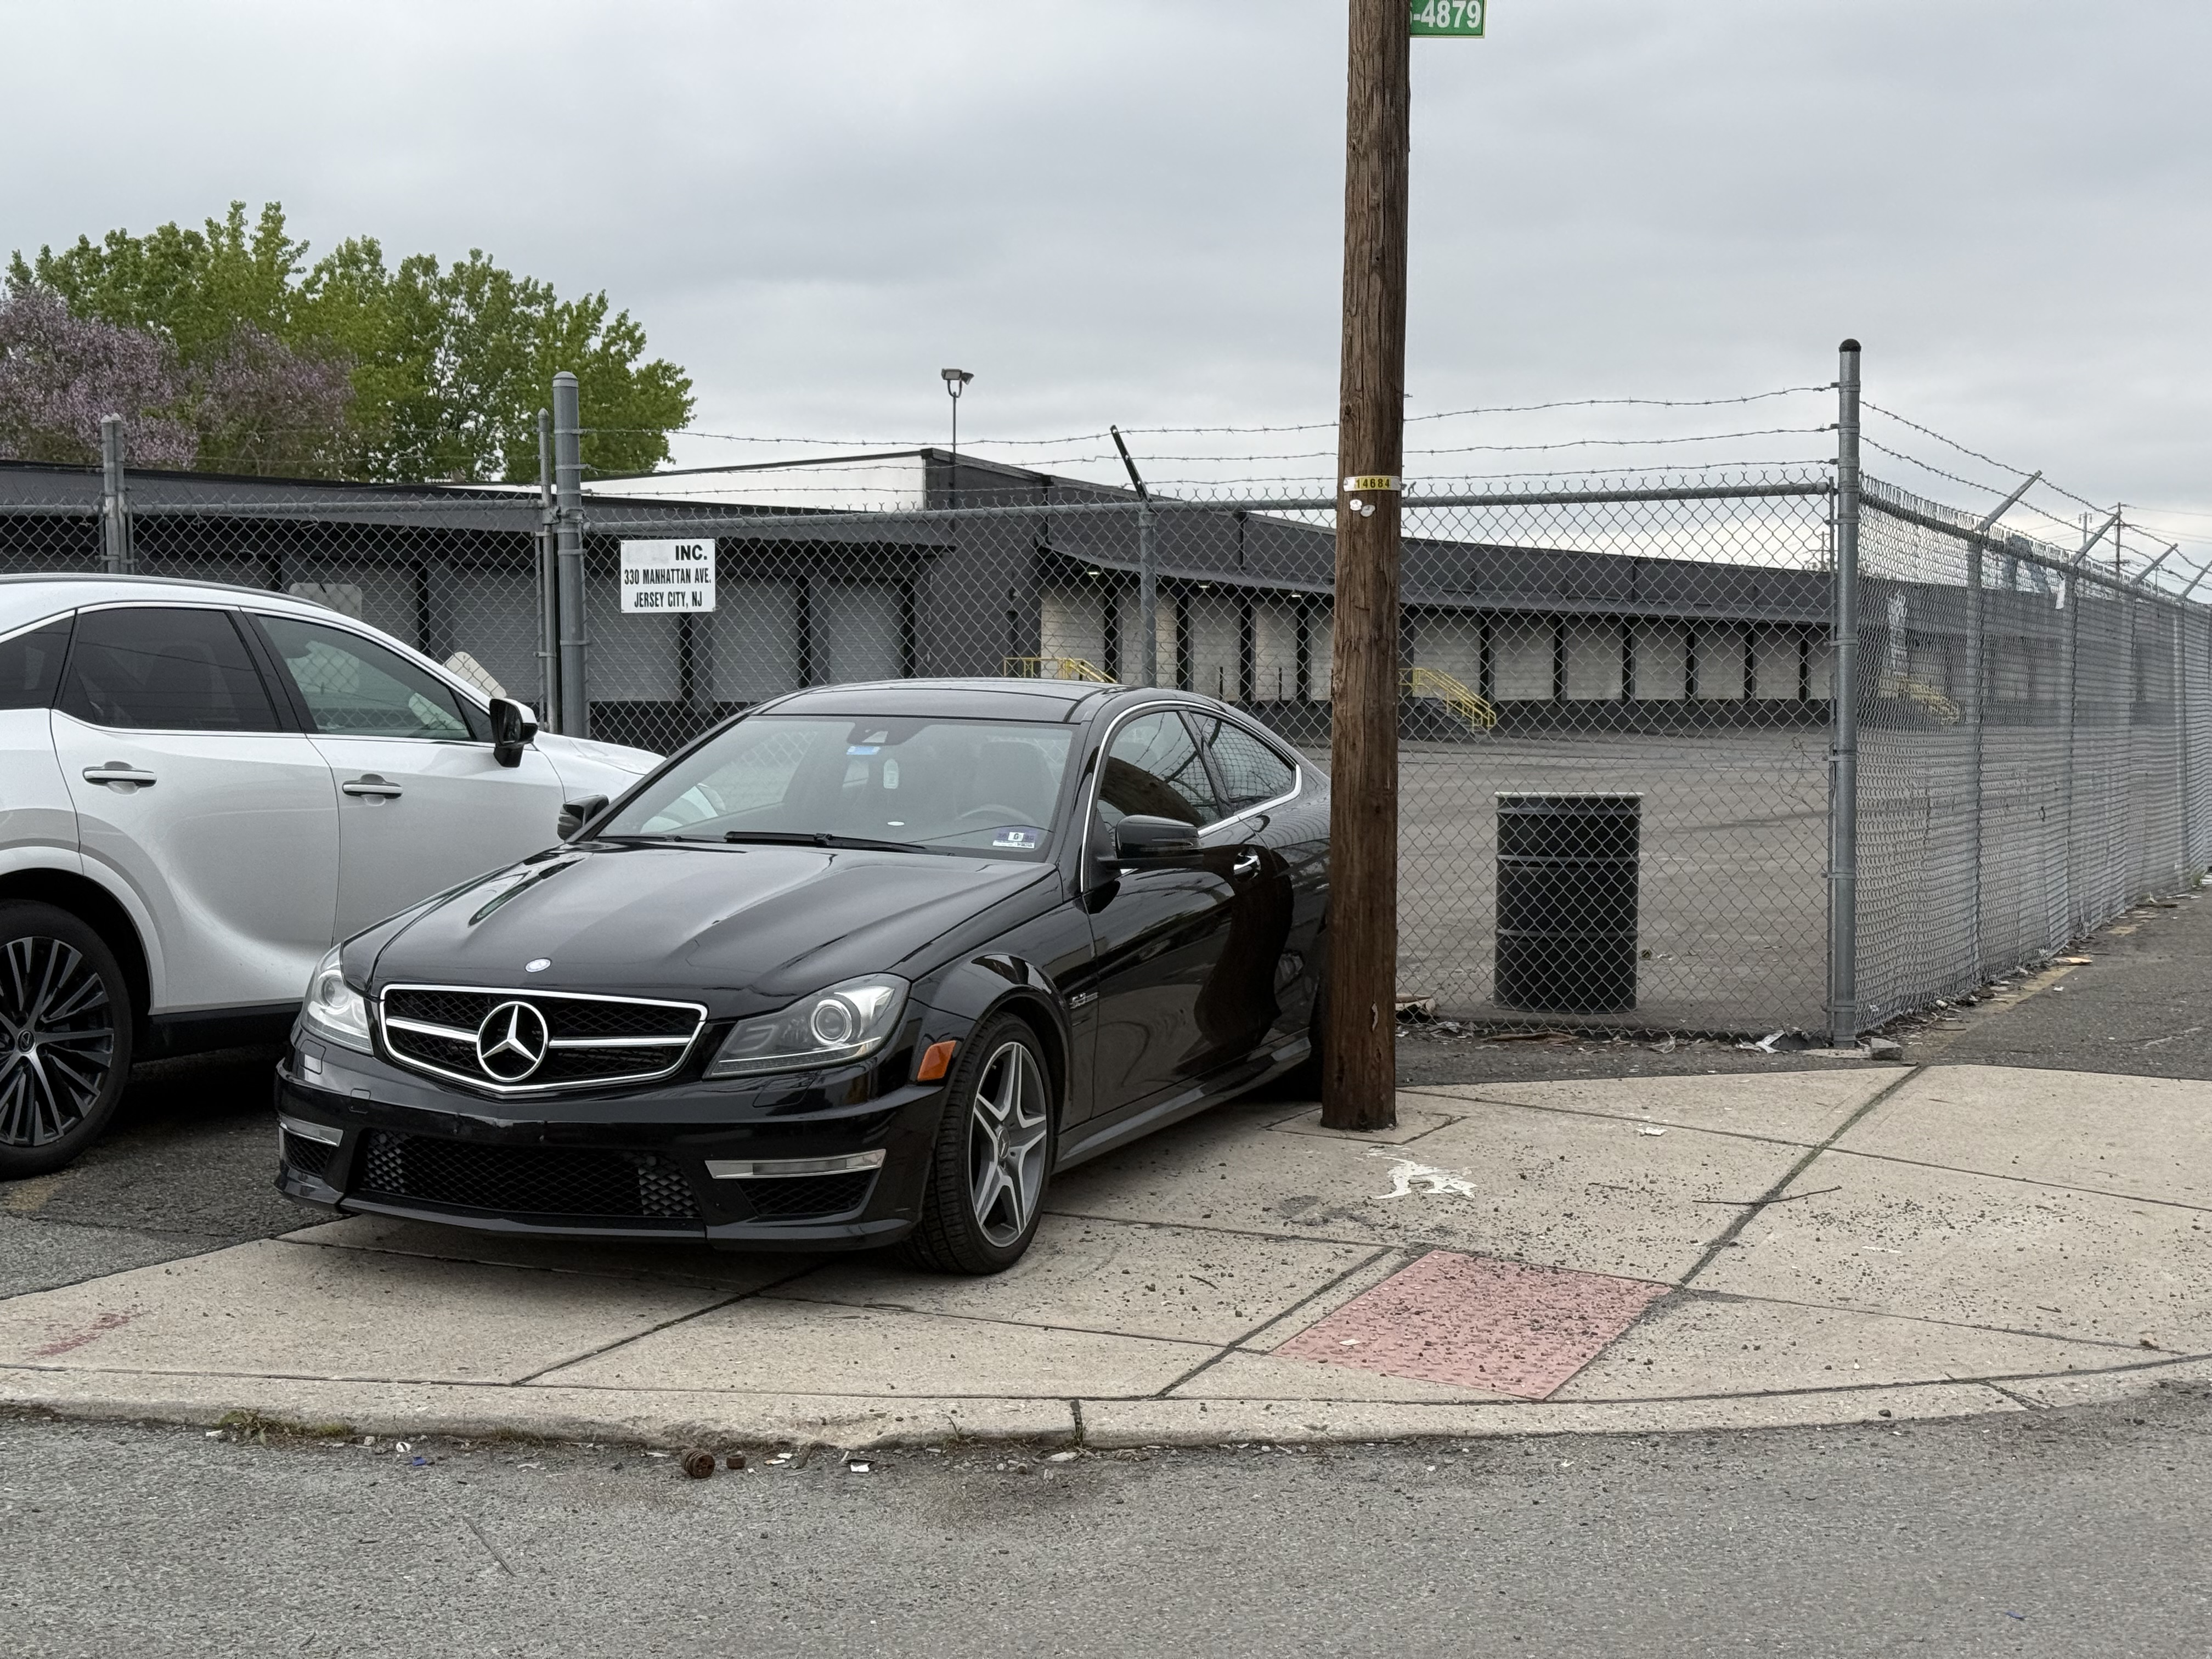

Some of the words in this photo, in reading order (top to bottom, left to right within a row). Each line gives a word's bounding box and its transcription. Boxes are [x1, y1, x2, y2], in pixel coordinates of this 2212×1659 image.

[1410, 0, 1481, 28] -4879
[675, 545, 708, 561] INC.
[624, 569, 640, 585] 330
[643, 568, 691, 584] MANHATTAN
[695, 568, 712, 584] AVE.
[634, 592, 664, 608] JERSEY
[668, 591, 689, 610] CITY,
[692, 591, 702, 607] NJ
